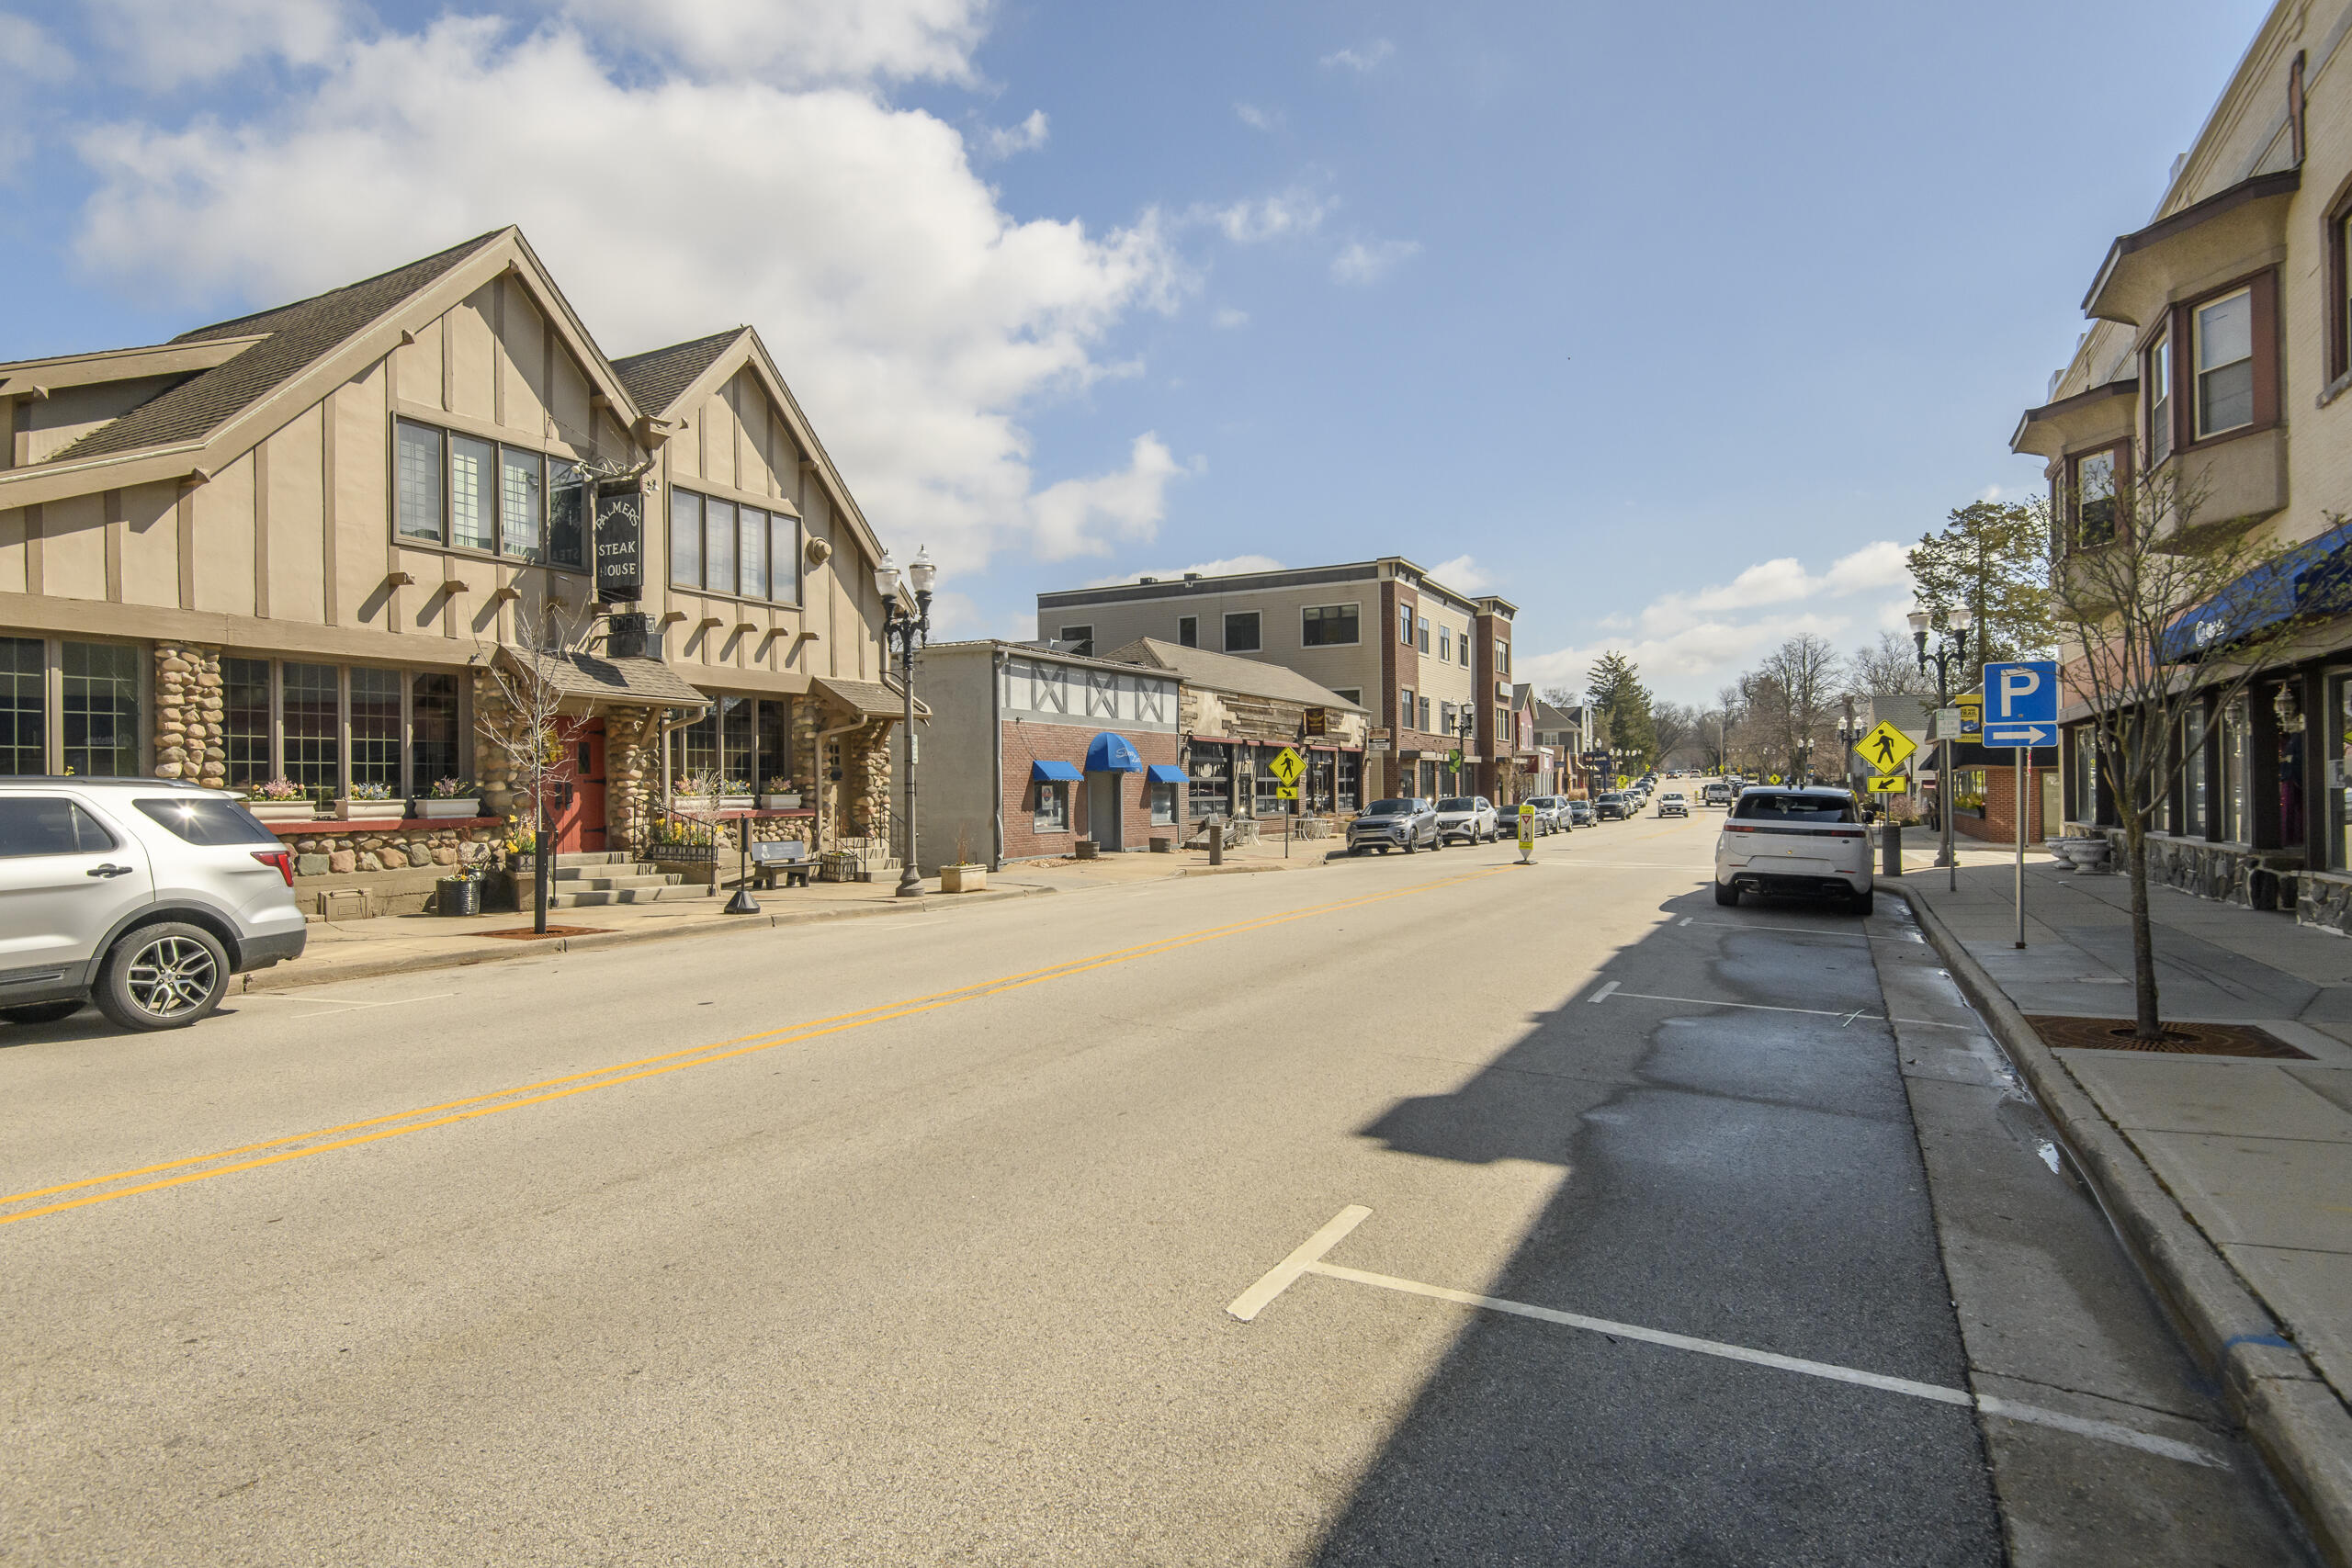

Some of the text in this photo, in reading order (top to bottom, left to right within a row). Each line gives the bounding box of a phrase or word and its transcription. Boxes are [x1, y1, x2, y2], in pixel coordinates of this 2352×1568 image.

[595, 501, 639, 531] PALMERS
[598, 541, 636, 557] STEAK
[2000, 668, 2041, 717] P
